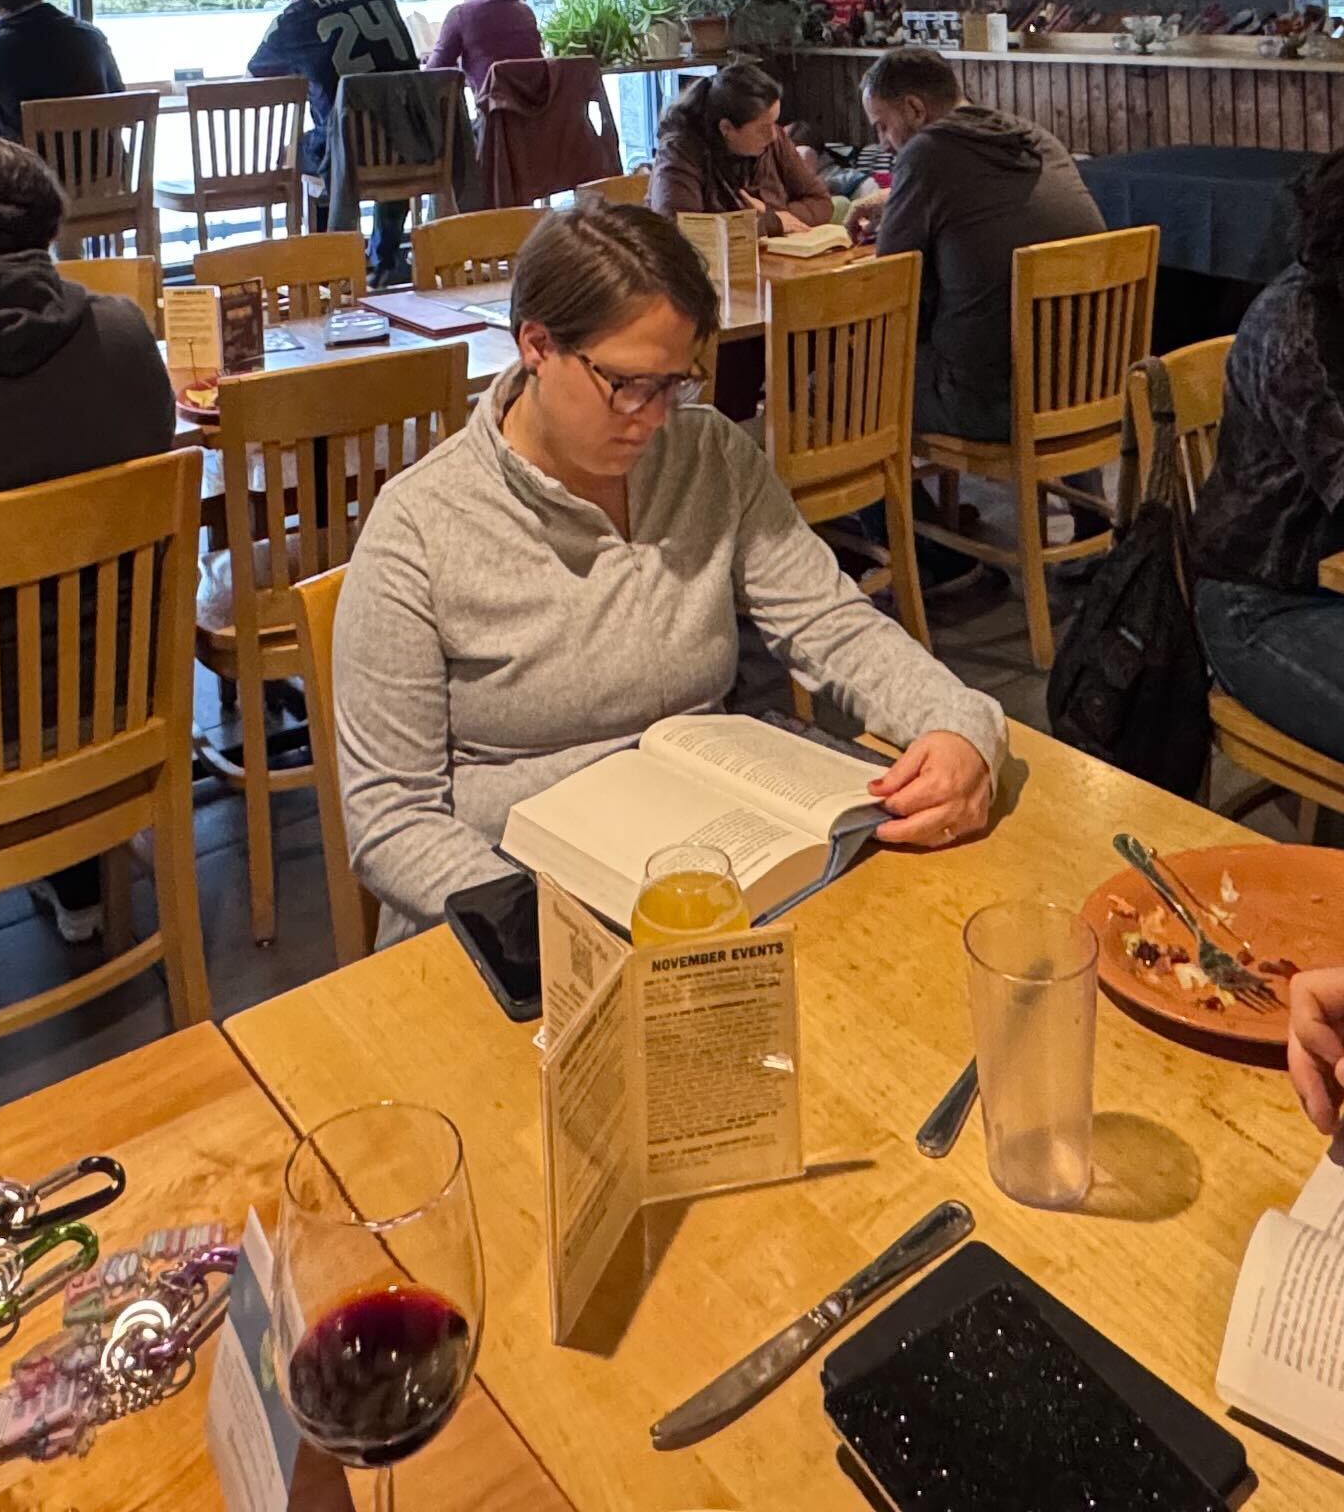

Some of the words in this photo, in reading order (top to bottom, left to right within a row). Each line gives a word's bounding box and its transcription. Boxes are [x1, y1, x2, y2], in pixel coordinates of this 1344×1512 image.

[317, 0, 409, 76] 24
[651, 950, 727, 973] NOVEMBER
[732, 942, 784, 961] EVENTS
